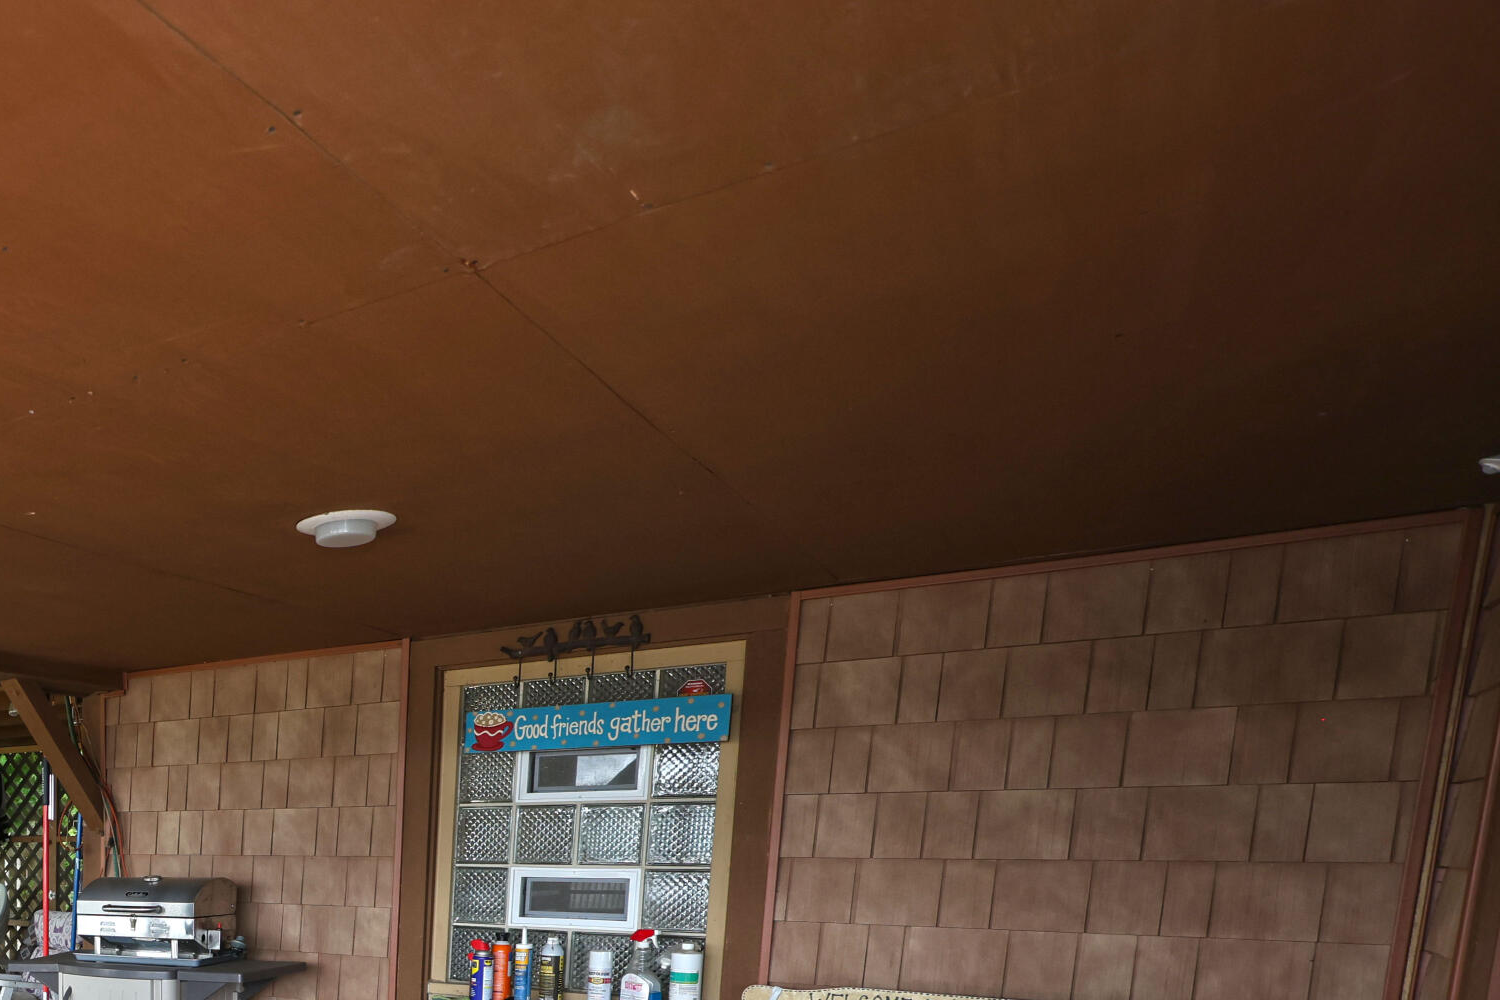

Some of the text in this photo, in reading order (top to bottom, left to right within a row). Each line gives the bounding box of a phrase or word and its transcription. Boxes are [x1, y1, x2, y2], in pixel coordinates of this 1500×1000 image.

[514, 706, 719, 741] Good friends gather here
